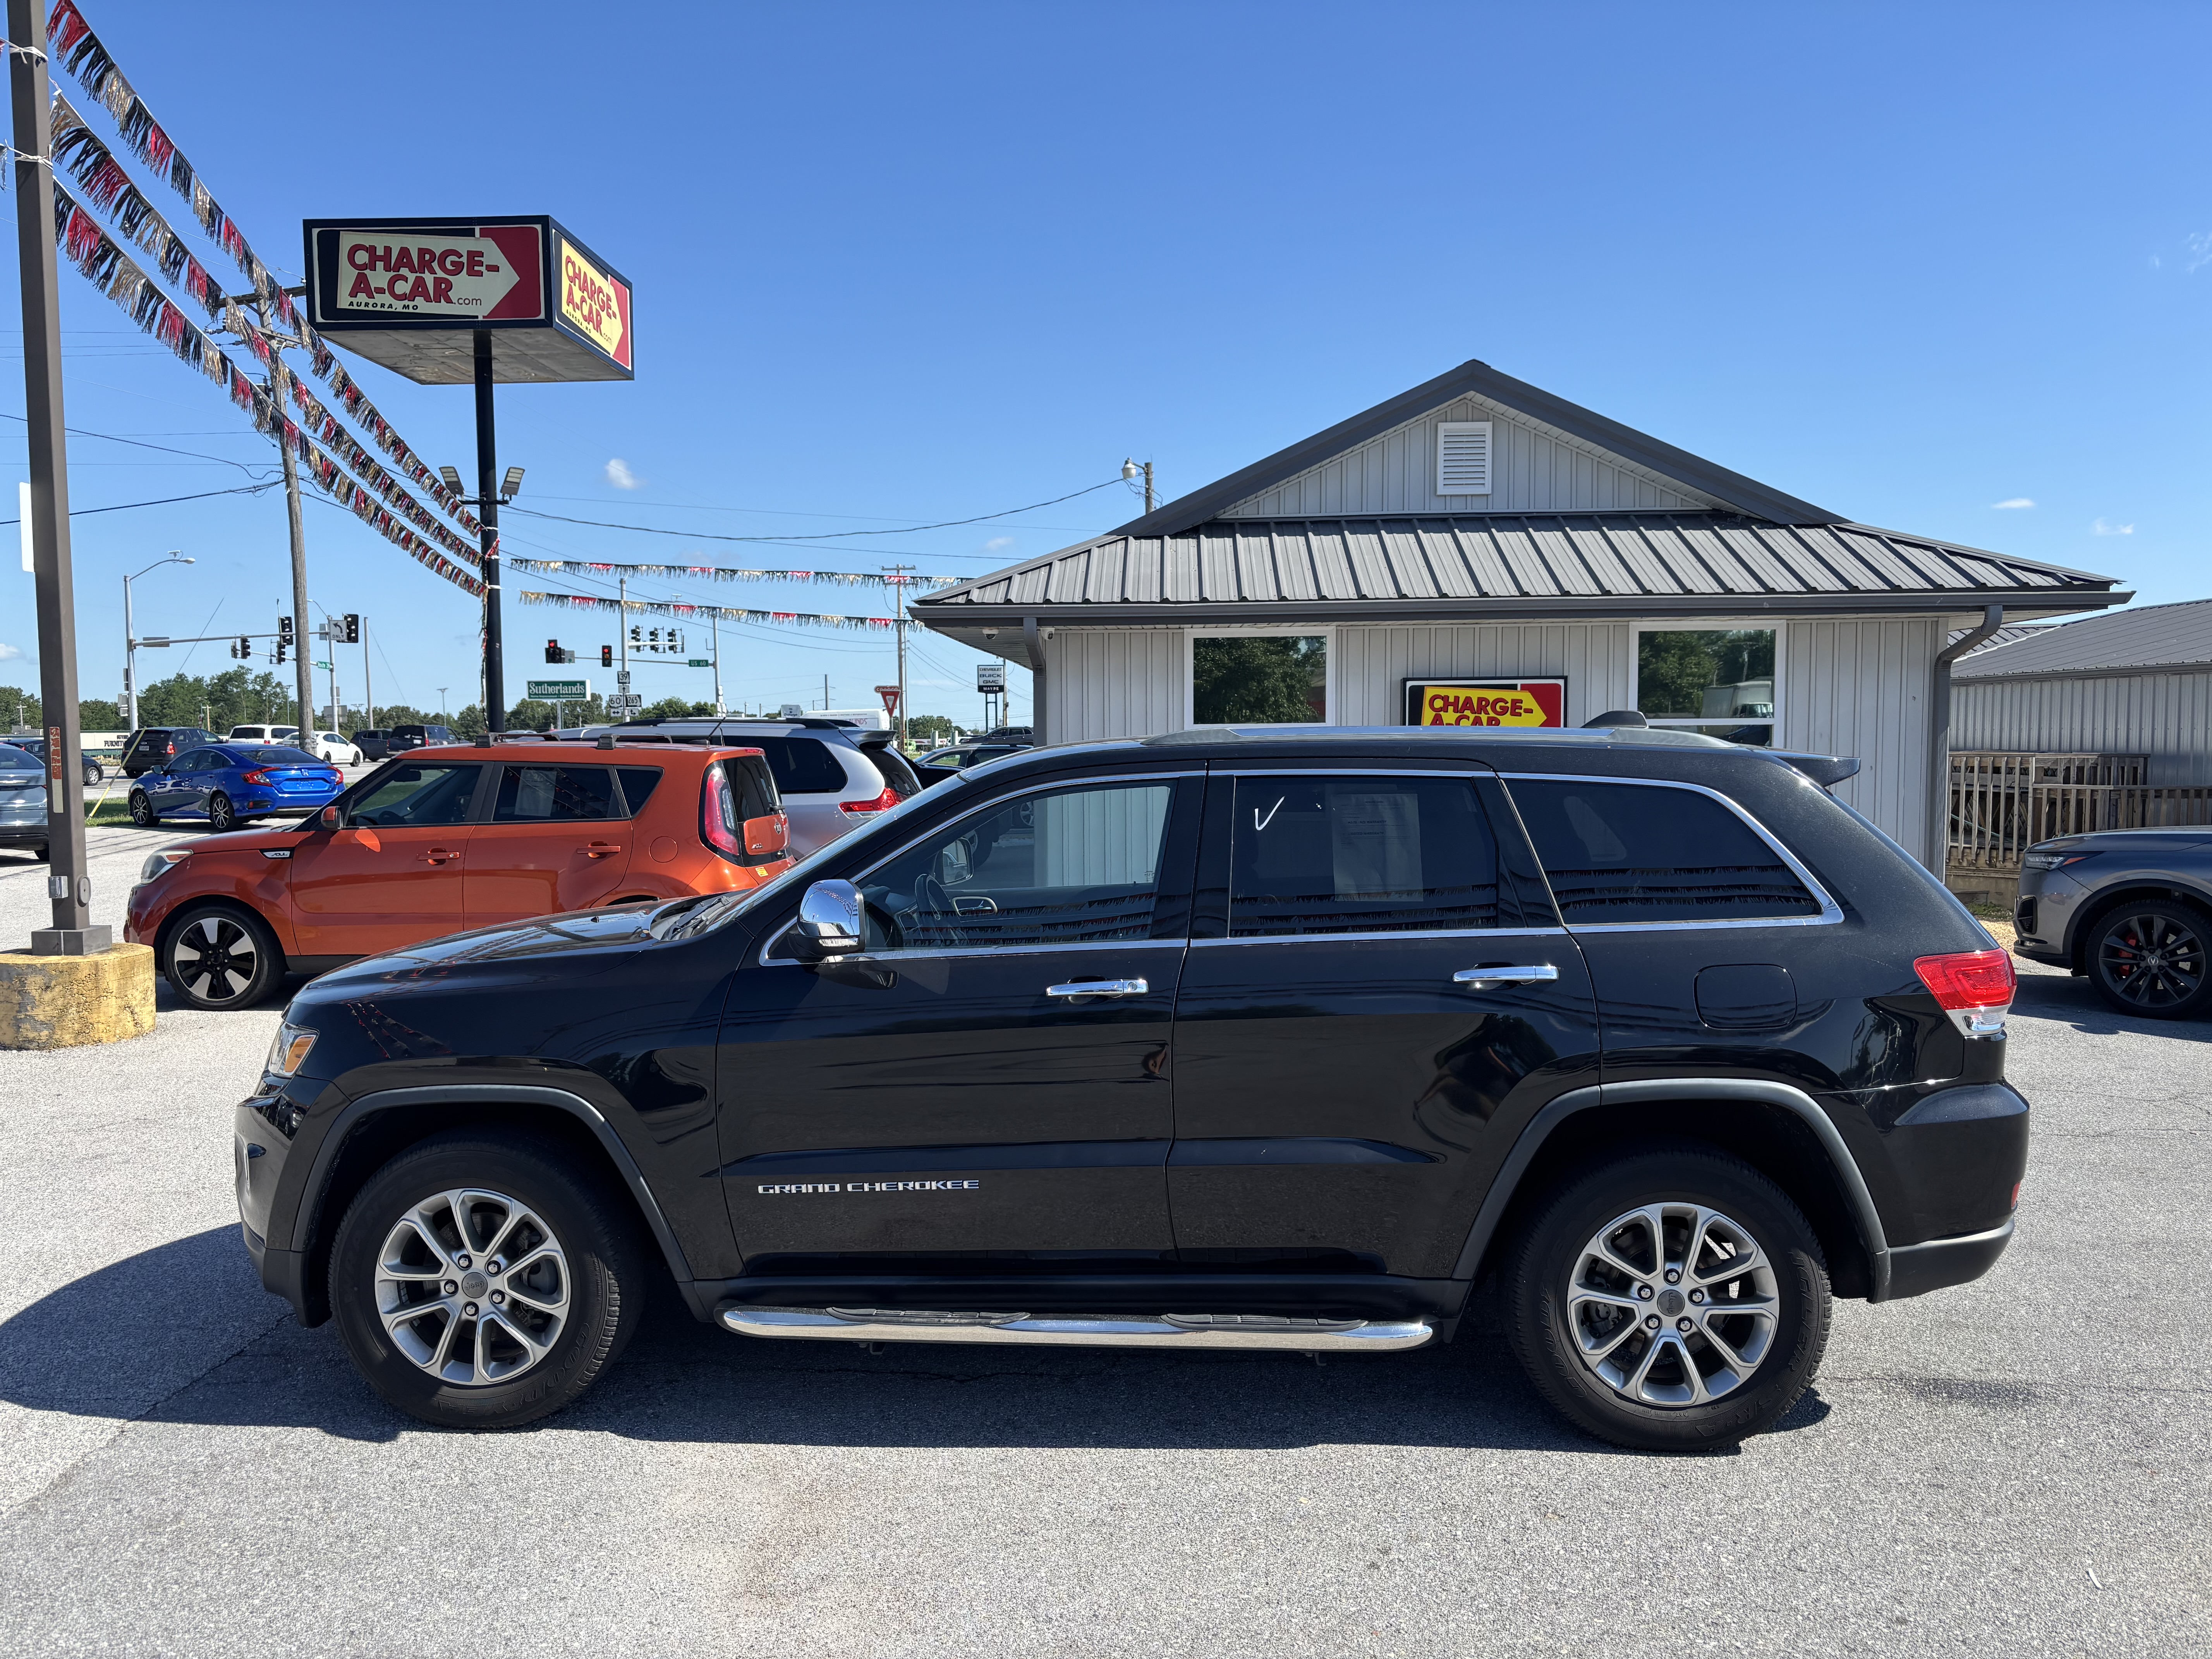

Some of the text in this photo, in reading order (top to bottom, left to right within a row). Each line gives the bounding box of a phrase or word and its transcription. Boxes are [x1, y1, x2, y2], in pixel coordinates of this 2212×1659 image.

[347, 244, 500, 277] CHARGE-
[565, 255, 617, 320] CHARGE-
[348, 301, 397, 310] AURORA,
[529, 682, 585, 694] Sutherlands
[1428, 694, 1534, 717] CHARGE-
[758, 1180, 979, 1194] GRAND CHEROKEE
[464, 1281, 484, 1290] Jeep
[1666, 1292, 1677, 1314] Jeep
